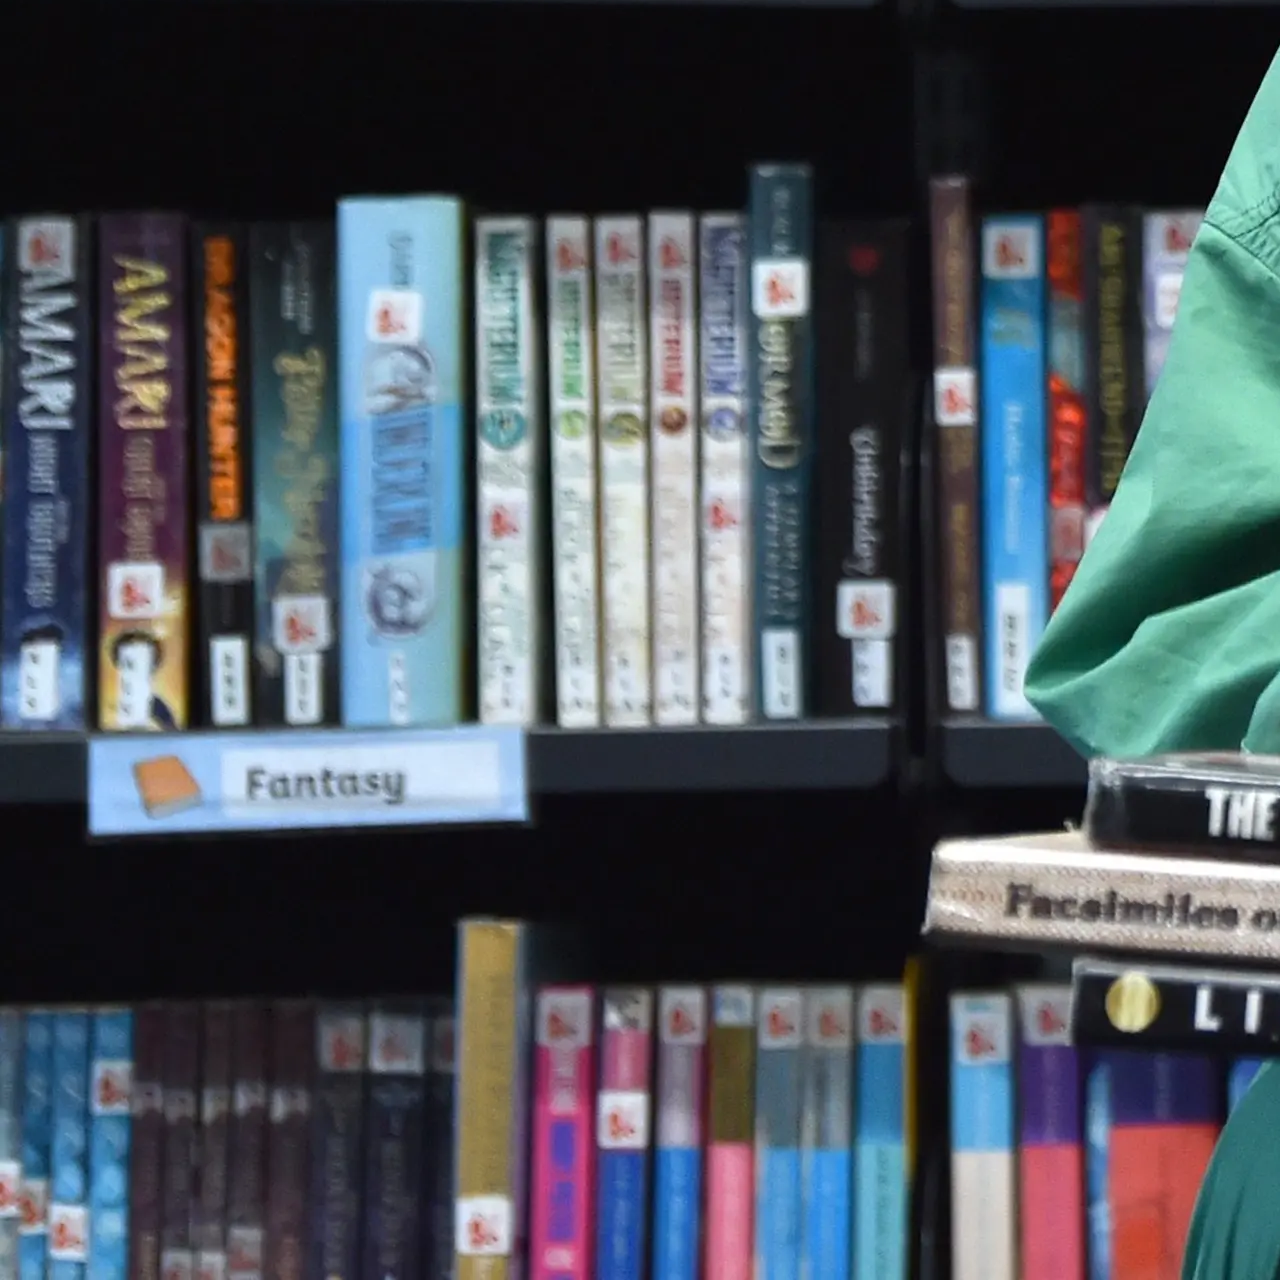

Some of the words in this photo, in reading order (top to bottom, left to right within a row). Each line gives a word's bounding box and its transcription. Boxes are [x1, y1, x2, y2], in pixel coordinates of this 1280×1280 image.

[113, 256, 172, 430] AMARI
[245, 766, 407, 805] Fantasy
[1204, 787, 1278, 841] THE
[1005, 880, 1240, 927] Facsimiles
